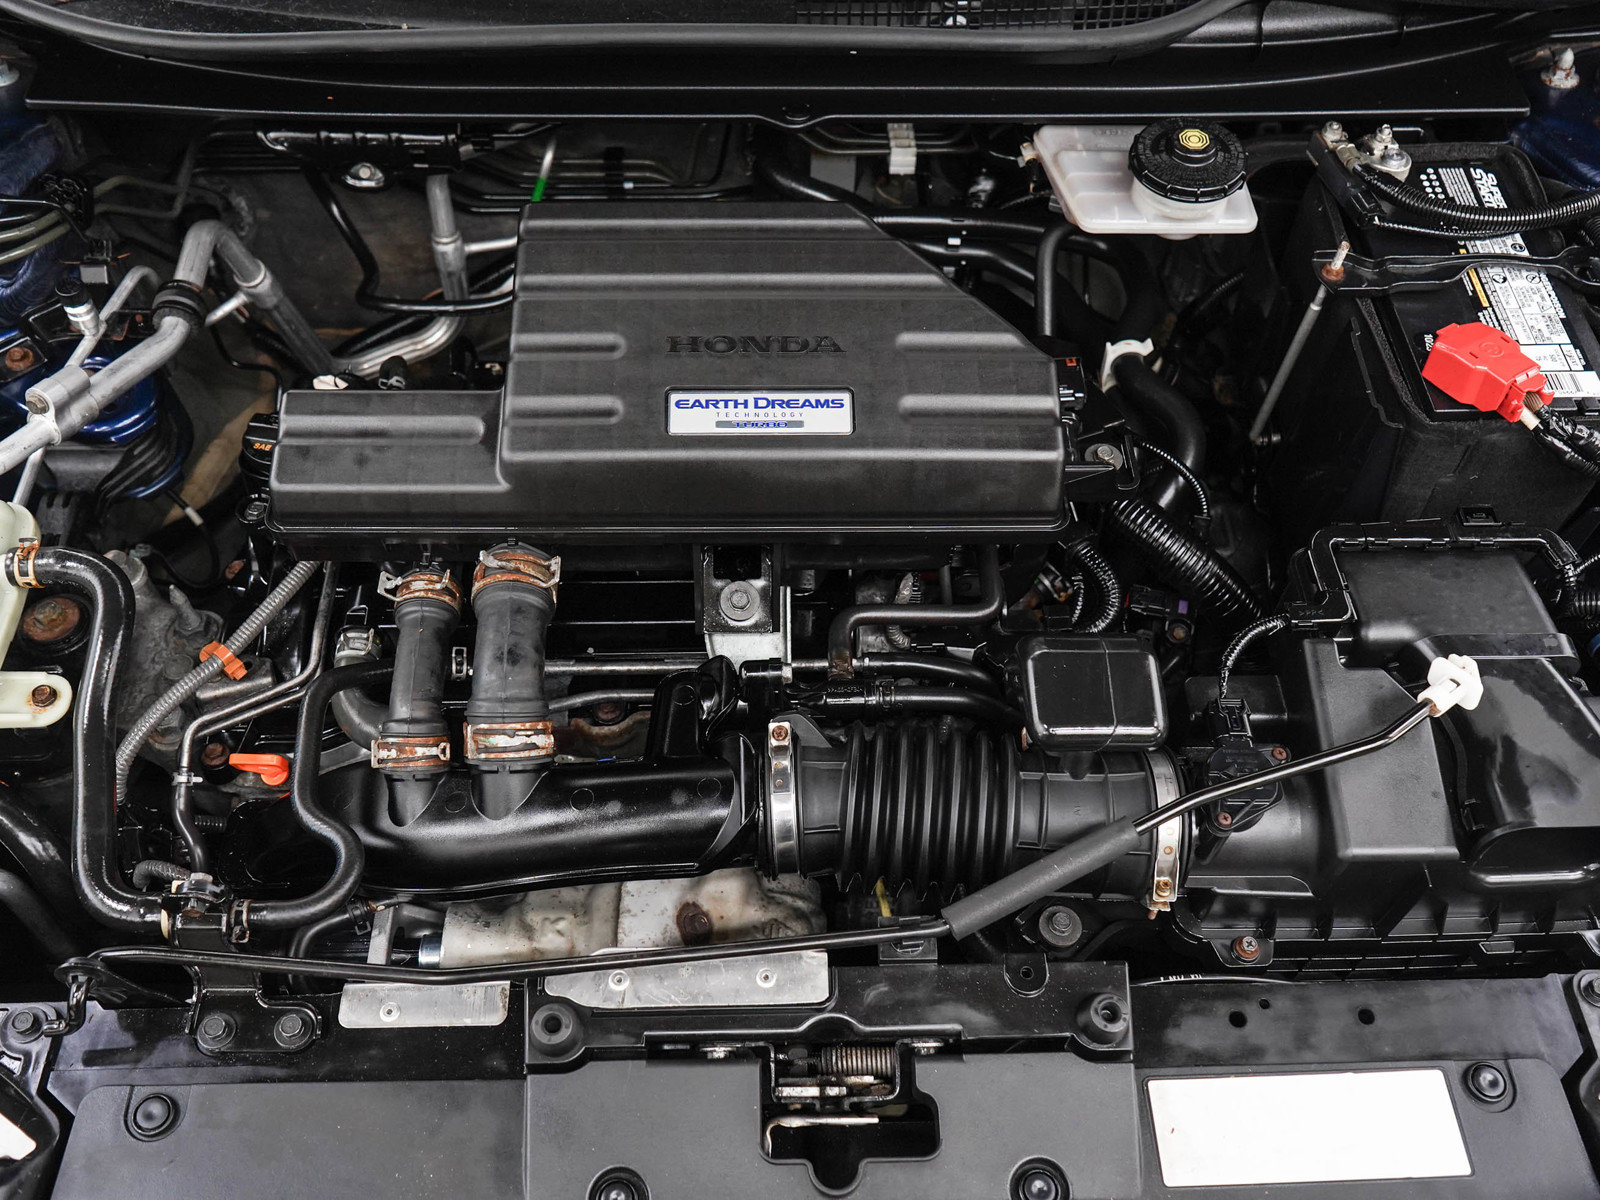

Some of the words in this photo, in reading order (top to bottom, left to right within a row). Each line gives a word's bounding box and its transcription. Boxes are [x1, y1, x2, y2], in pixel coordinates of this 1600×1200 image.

[1470, 167, 1498, 209] START
[1487, 172, 1508, 209] SUPER
[665, 335, 847, 353] HONDA
[674, 398, 749, 410] EARTH
[753, 397, 845, 410] DREAMS
[732, 421, 788, 429] TURBO
